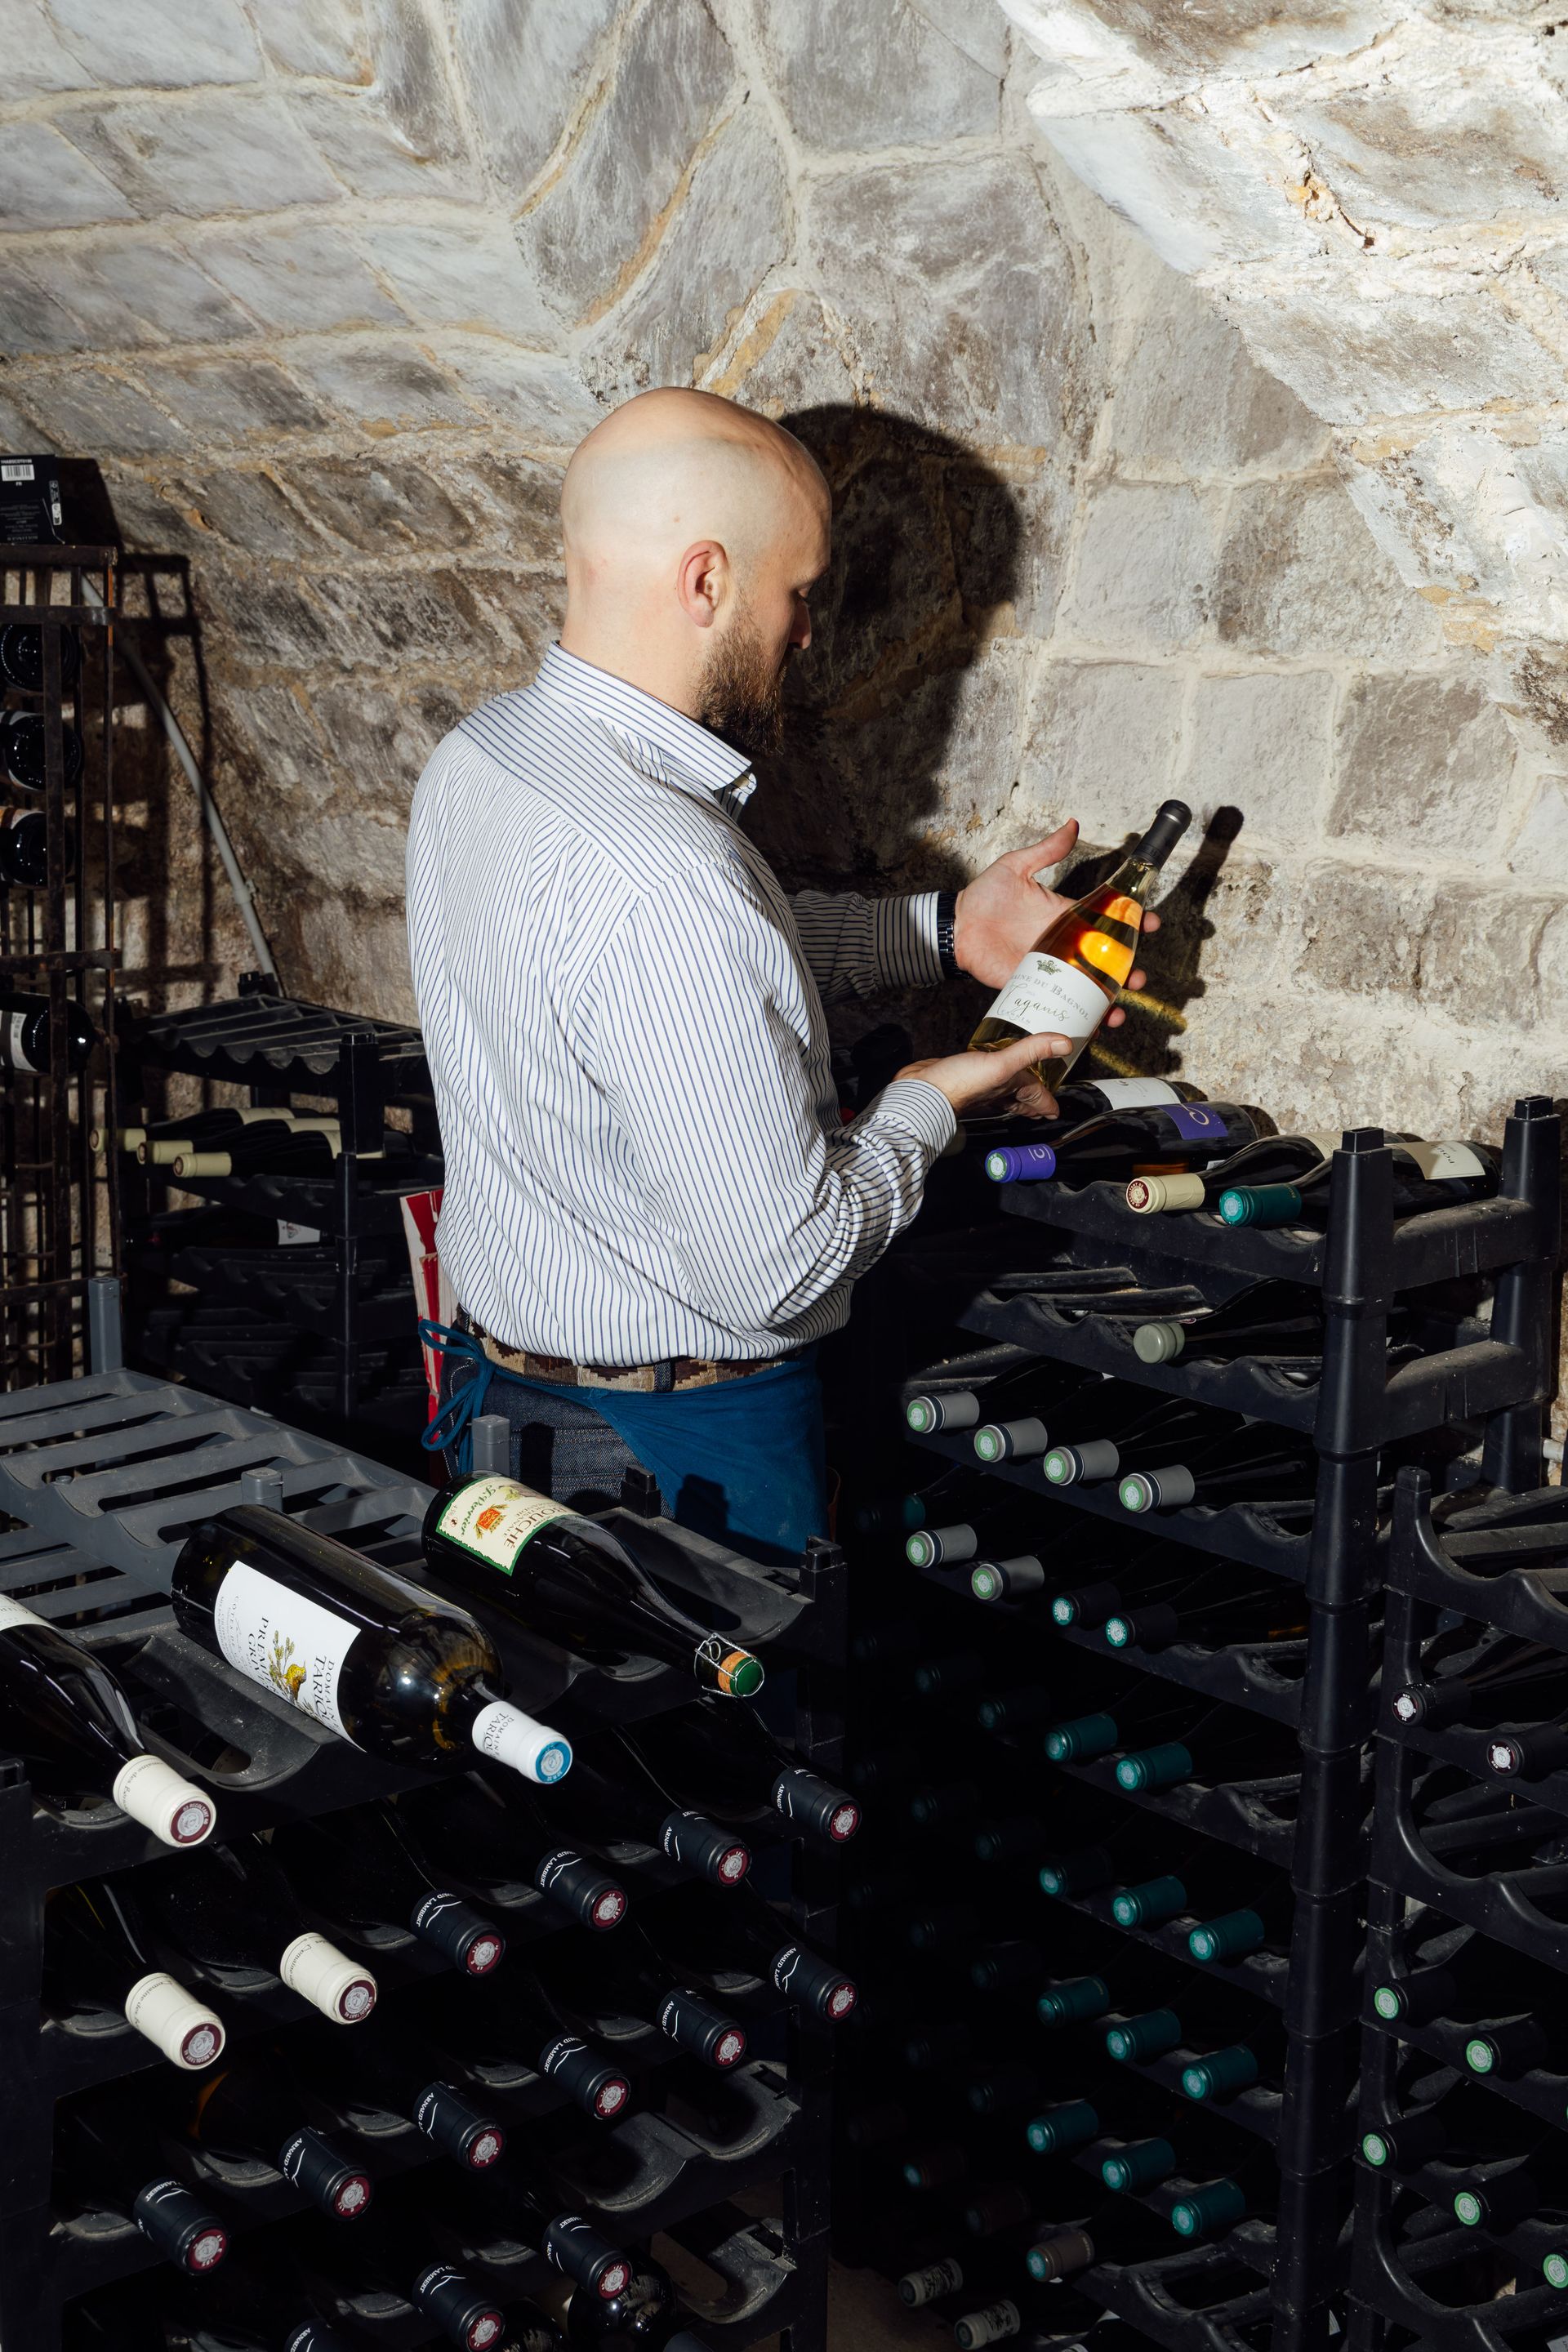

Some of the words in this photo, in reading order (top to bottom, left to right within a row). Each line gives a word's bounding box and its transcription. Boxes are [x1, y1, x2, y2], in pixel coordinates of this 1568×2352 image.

[1051, 985, 1090, 1021] BAGNOL
[540, 1856, 558, 1888] LAMBERT
[416, 1897, 437, 1928] LAMBERT
[777, 1946, 797, 1969] ARNAUD
[662, 1999, 675, 2027] ARNAUD
[543, 2042, 564, 2073] LAMBERT
[417, 2091, 434, 2121] ARNAUD
[283, 2136, 303, 2167] ARNAUD
[420, 2265, 446, 2295] LAMBERT
